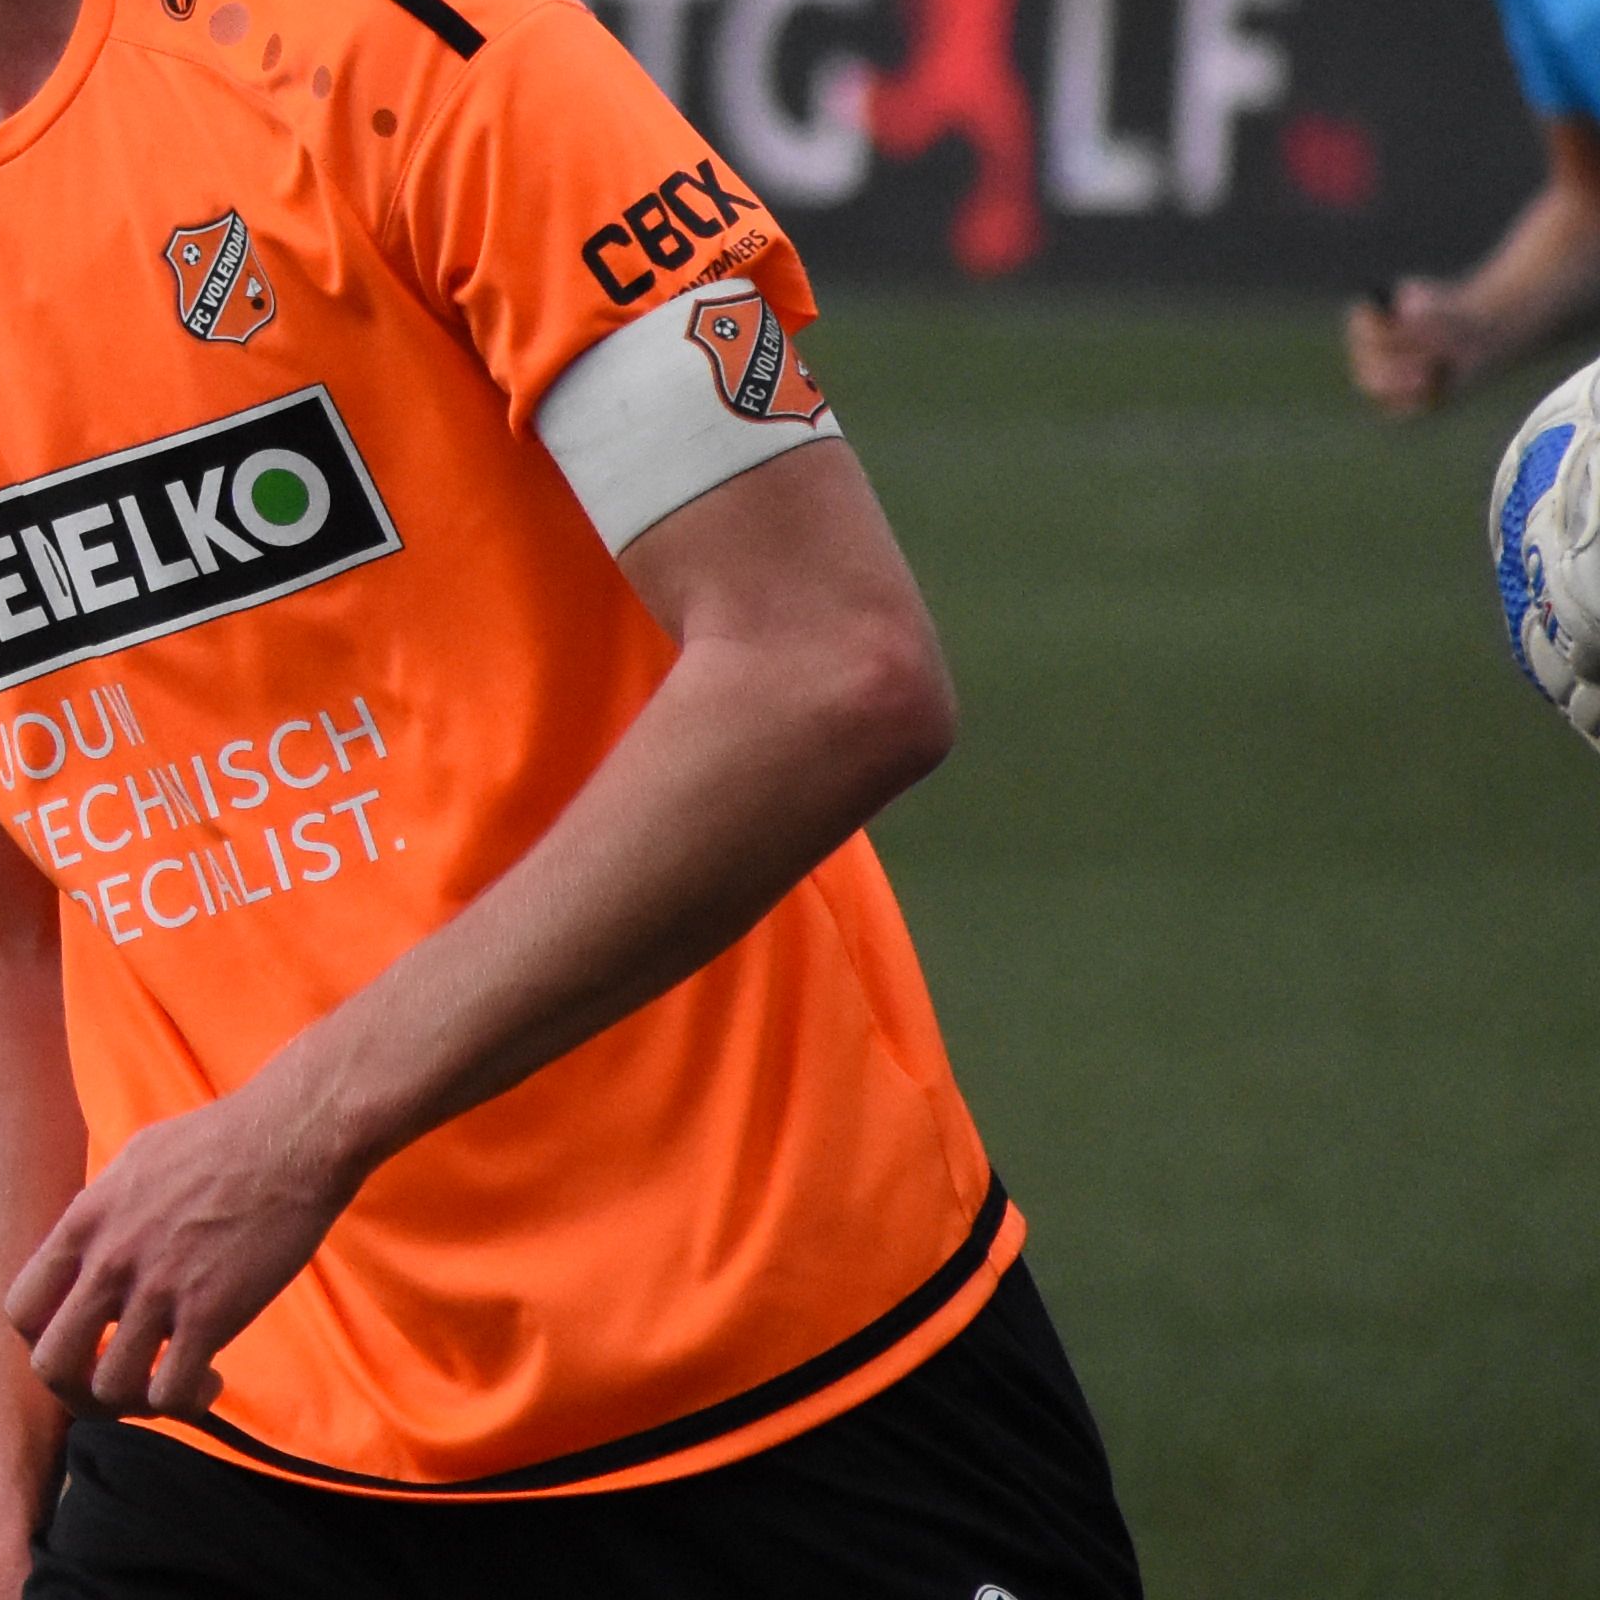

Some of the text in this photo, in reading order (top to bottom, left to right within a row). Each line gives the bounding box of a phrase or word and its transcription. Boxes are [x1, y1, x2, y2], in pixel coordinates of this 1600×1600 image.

[189, 309, 212, 335] FC
[741, 384, 767, 412] FC
[13, 696, 388, 870] TECHNISCH
